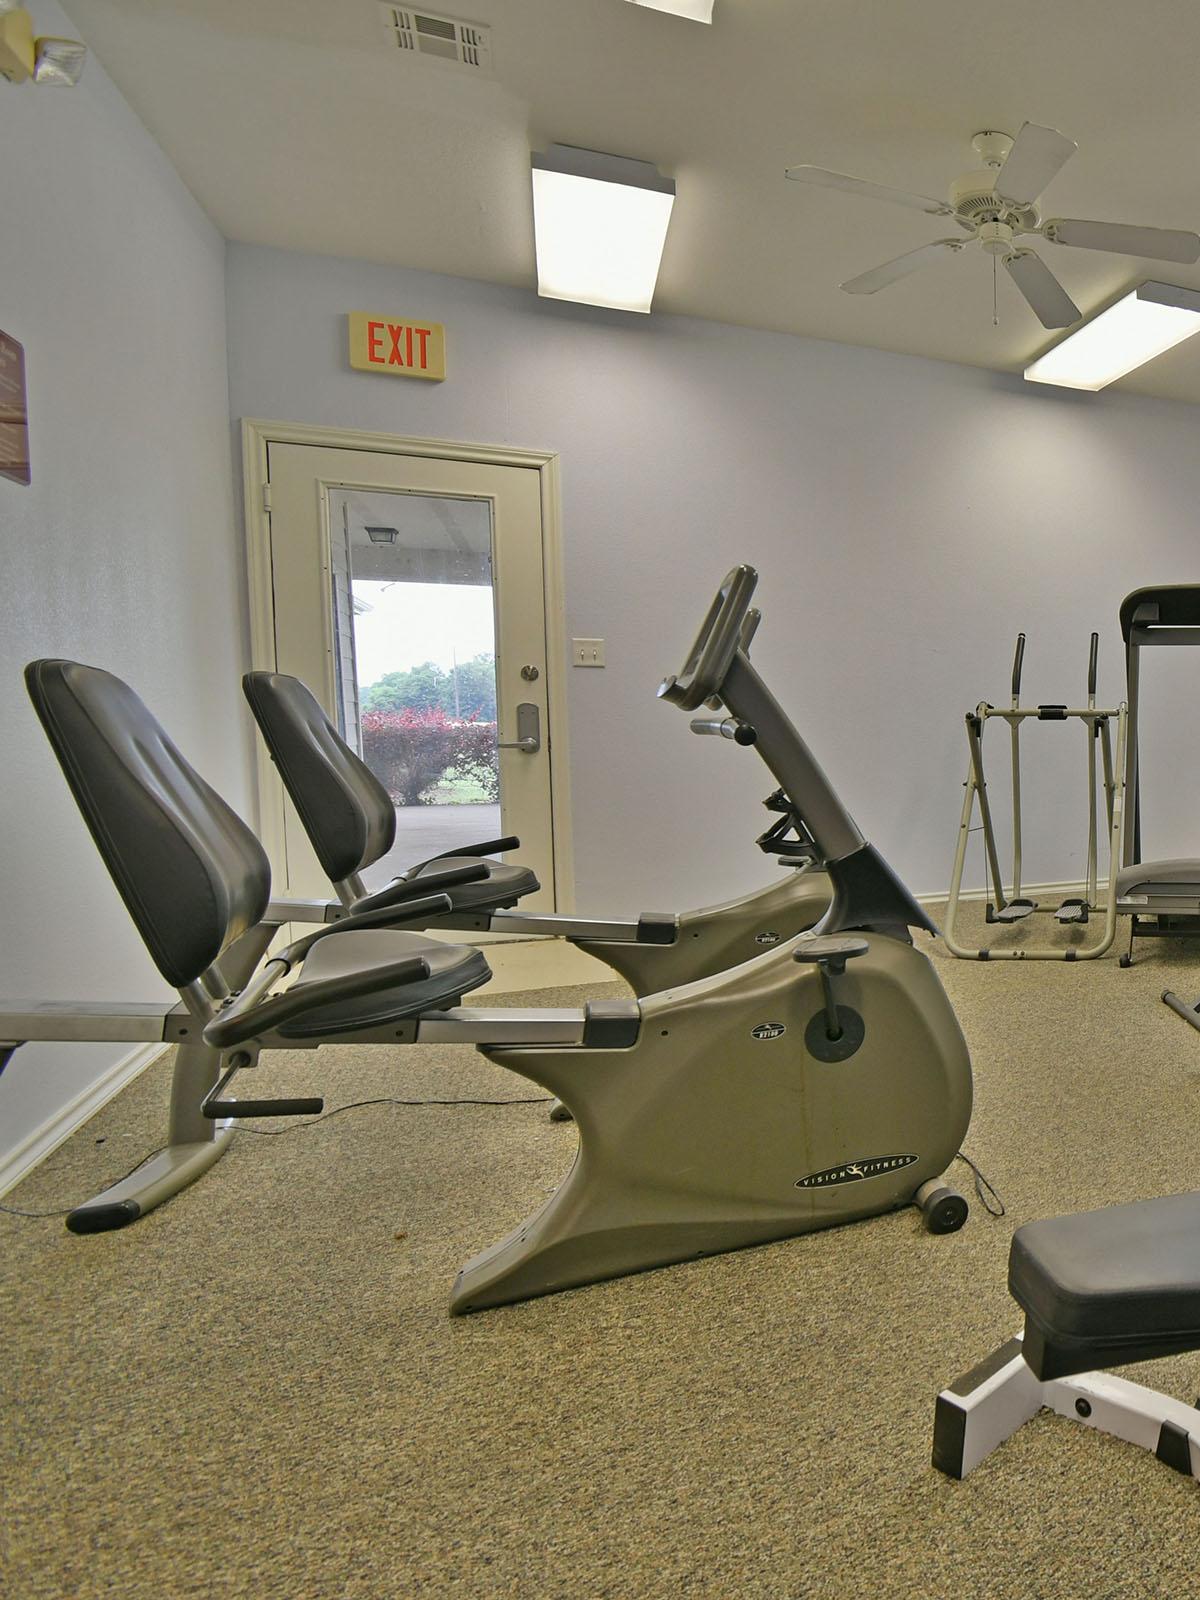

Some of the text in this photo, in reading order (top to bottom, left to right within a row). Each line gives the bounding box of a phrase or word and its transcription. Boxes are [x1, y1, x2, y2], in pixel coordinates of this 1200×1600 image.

[367, 321, 431, 369] EXIT
[803, 1156, 911, 1186] VISION FITNESS
